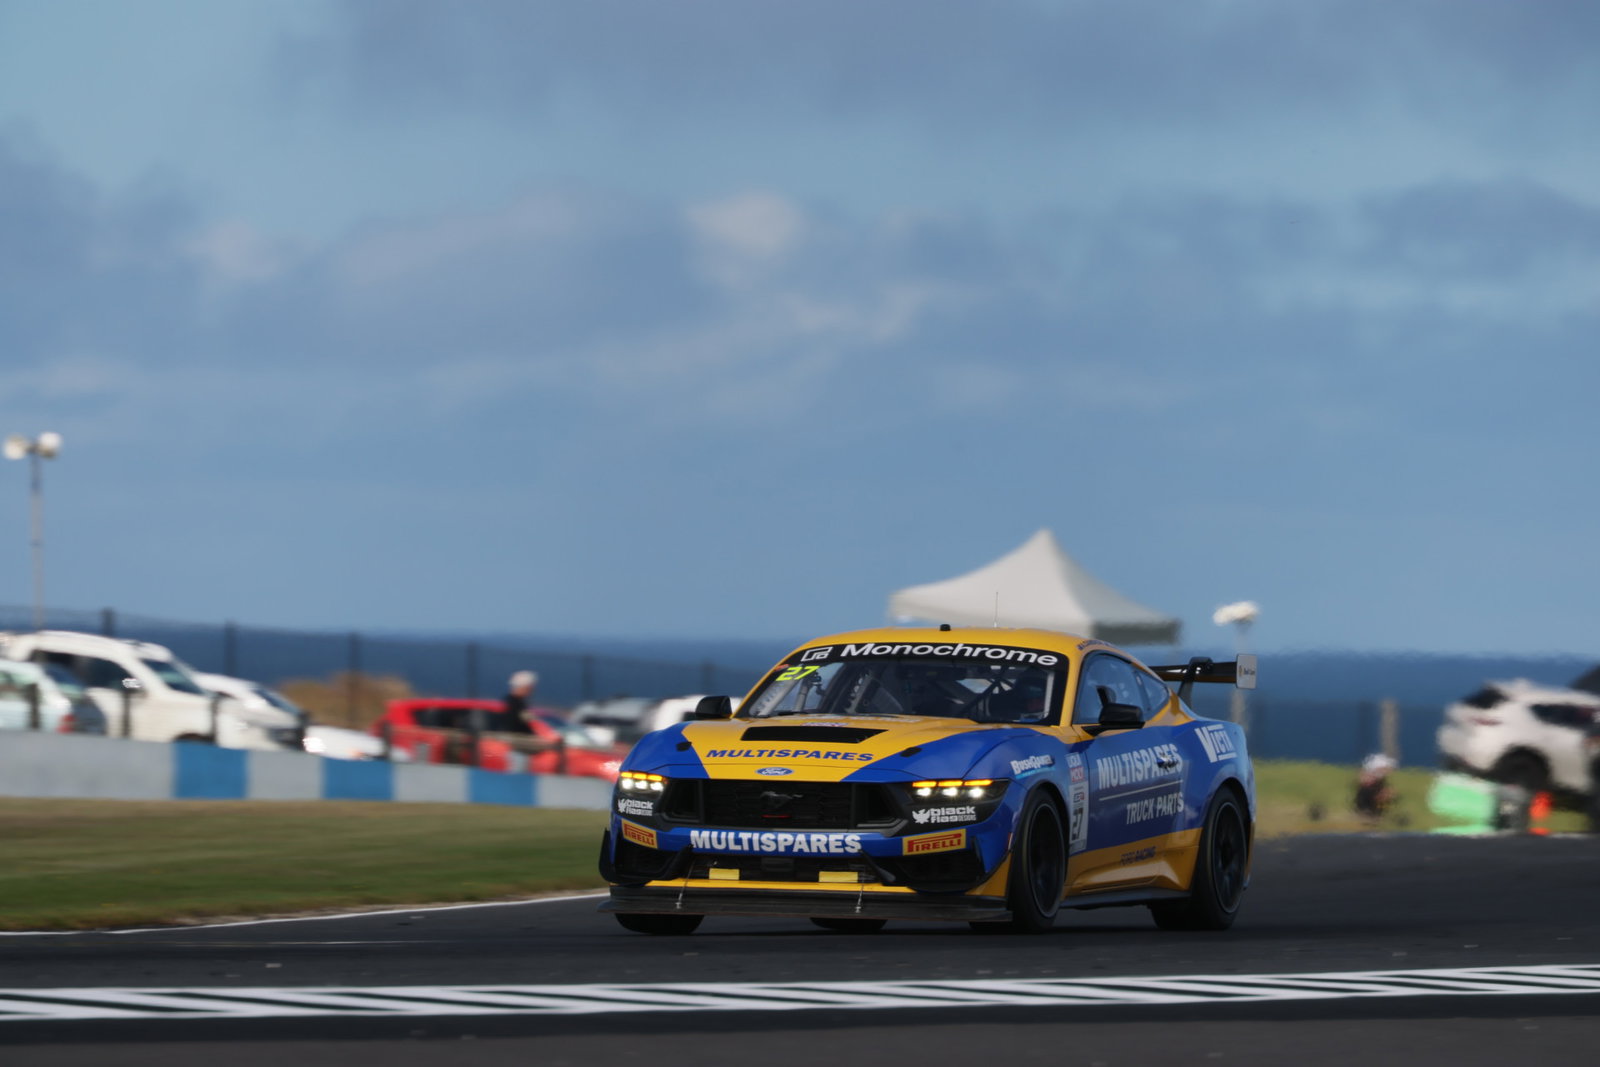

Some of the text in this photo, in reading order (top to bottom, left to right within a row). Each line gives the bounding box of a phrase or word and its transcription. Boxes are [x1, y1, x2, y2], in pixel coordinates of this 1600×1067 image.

[840, 643, 1058, 666] Monochrome
[775, 665, 820, 682] 27
[706, 749, 874, 762] MULTISPARES
[1096, 743, 1183, 789] MULTISPARES
[930, 805, 976, 816] black
[1126, 791, 1184, 825] TRUCK PARTS
[930, 814, 958, 823] flag
[690, 830, 862, 853] MULTISPARES
[907, 833, 962, 853] PIRELLI
